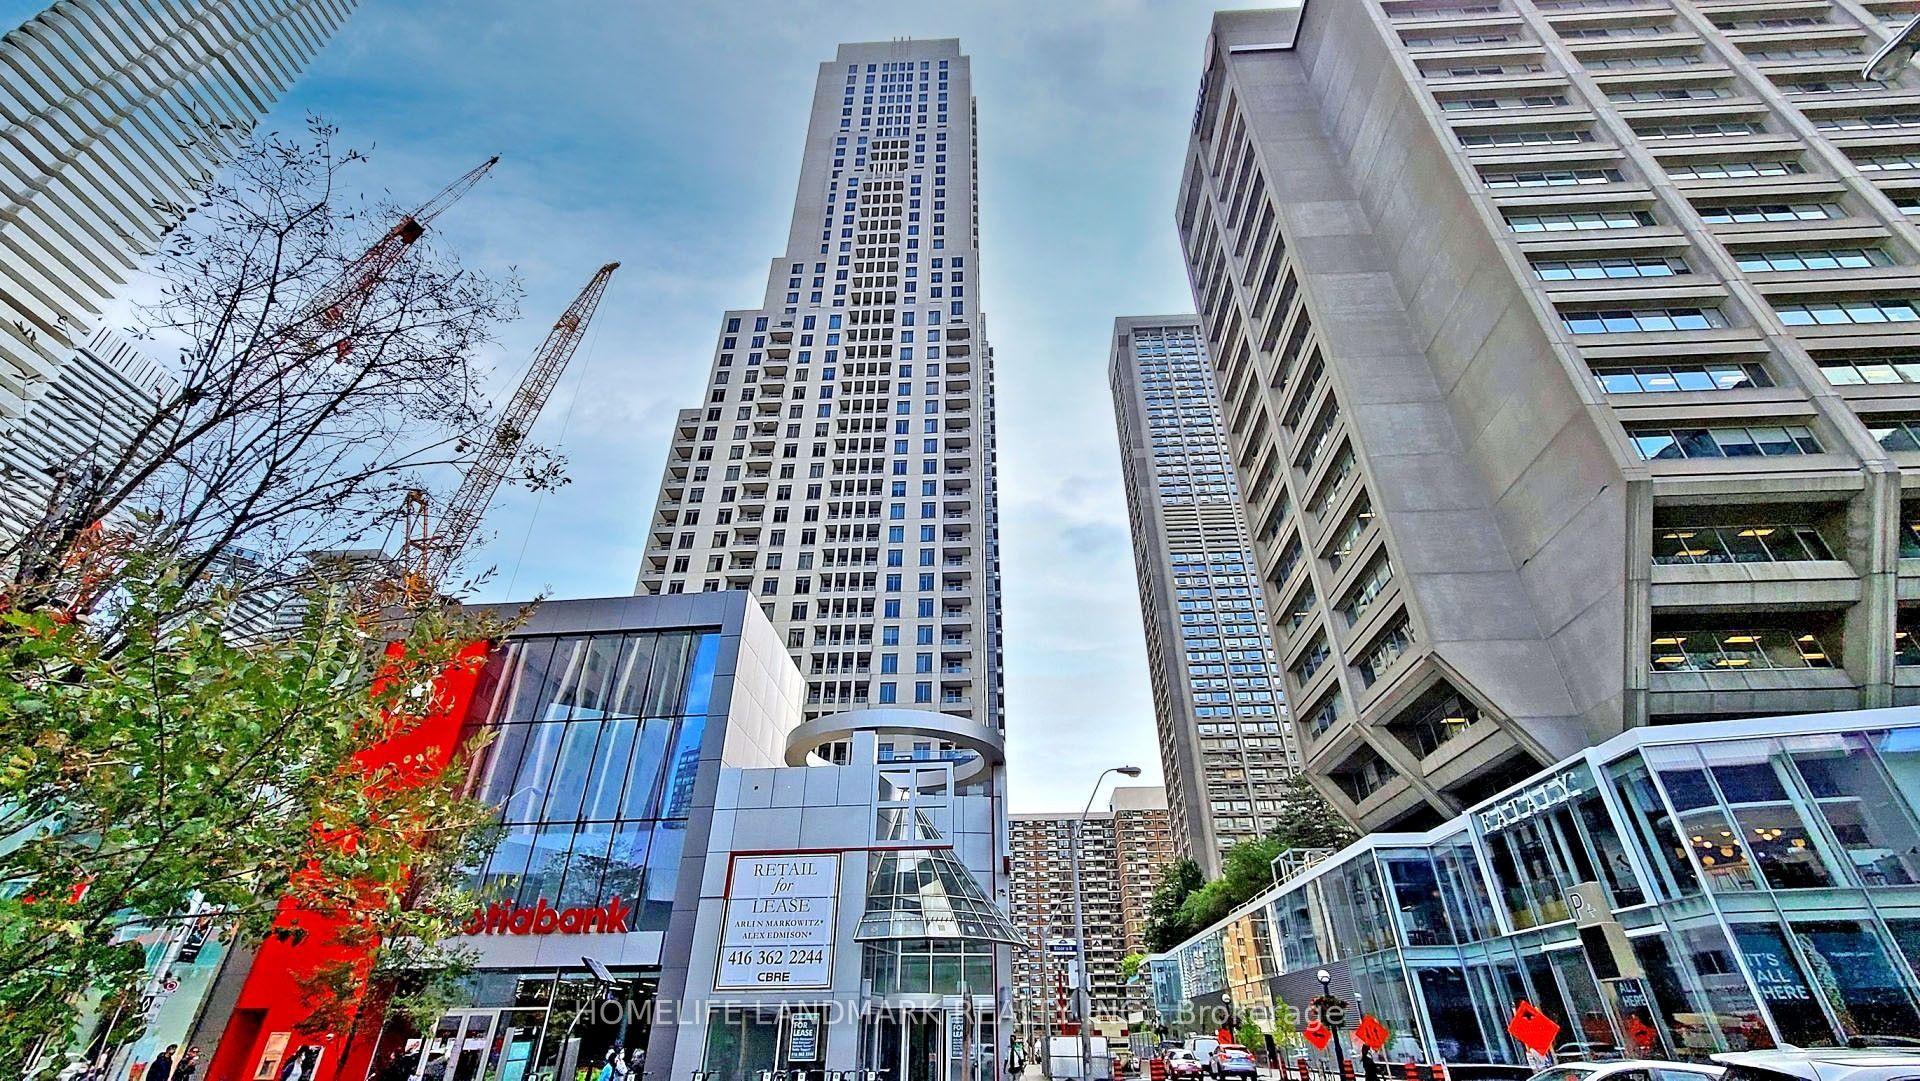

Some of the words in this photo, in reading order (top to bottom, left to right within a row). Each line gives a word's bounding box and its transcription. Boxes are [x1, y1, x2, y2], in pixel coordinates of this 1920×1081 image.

[1479, 771, 1582, 834] EATALY
[753, 862, 818, 877] RETAIL
[771, 877, 794, 896] for
[752, 898, 811, 914] LEASE
[734, 920, 763, 928] ARLIN
[742, 931, 766, 940] ALEX
[728, 950, 752, 966] 416
[756, 950, 783, 966] 362
[788, 949, 823, 965] 2244
[1744, 952, 1780, 967] IT'S
[757, 971, 791, 982] CBRE
[1757, 969, 1791, 983] ALL
[1761, 985, 1810, 1000] HERE
[794, 1021, 808, 1029] FOR
[793, 1029, 813, 1037] LEASE
